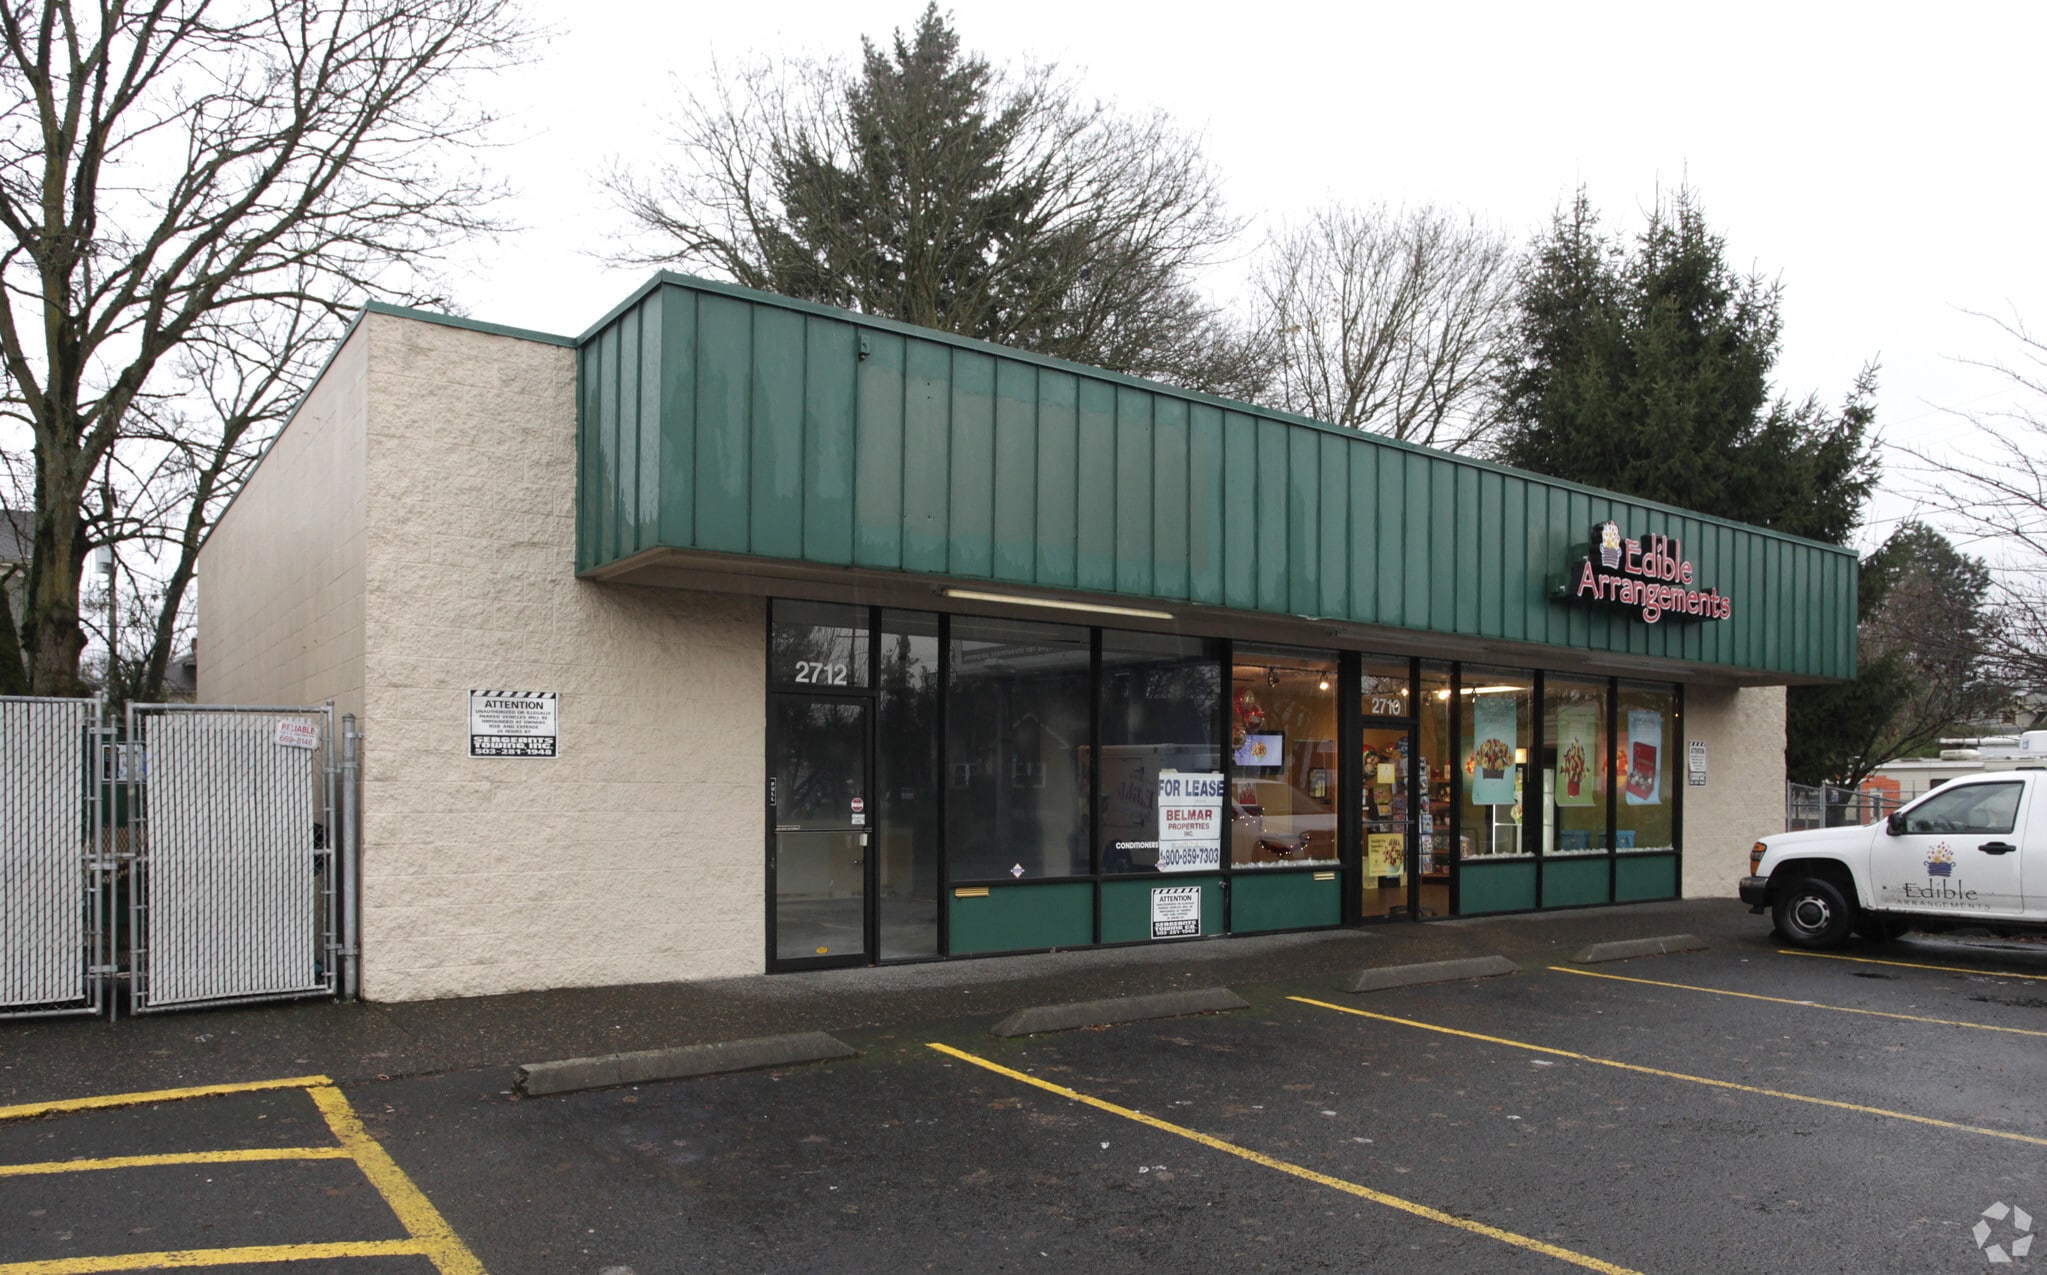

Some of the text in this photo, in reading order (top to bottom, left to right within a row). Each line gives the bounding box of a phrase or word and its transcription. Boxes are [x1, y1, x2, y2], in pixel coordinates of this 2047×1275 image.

[1625, 532, 1693, 585] Edible
[1577, 561, 1731, 624] Arrangements
[795, 661, 847, 686] 2712
[484, 700, 544, 710] ATTENTION
[1159, 779, 1224, 797] FOR LEASE
[1166, 809, 1213, 821] BELMAR
[1168, 822, 1210, 831] PROPERTIES
[1115, 841, 1159, 849] CONDITIONERS
[1160, 848, 1219, 866] 1-800-859-7303
[1903, 878, 1978, 901] Edible
[1897, 899, 1991, 911] ARRANGEMENTS
